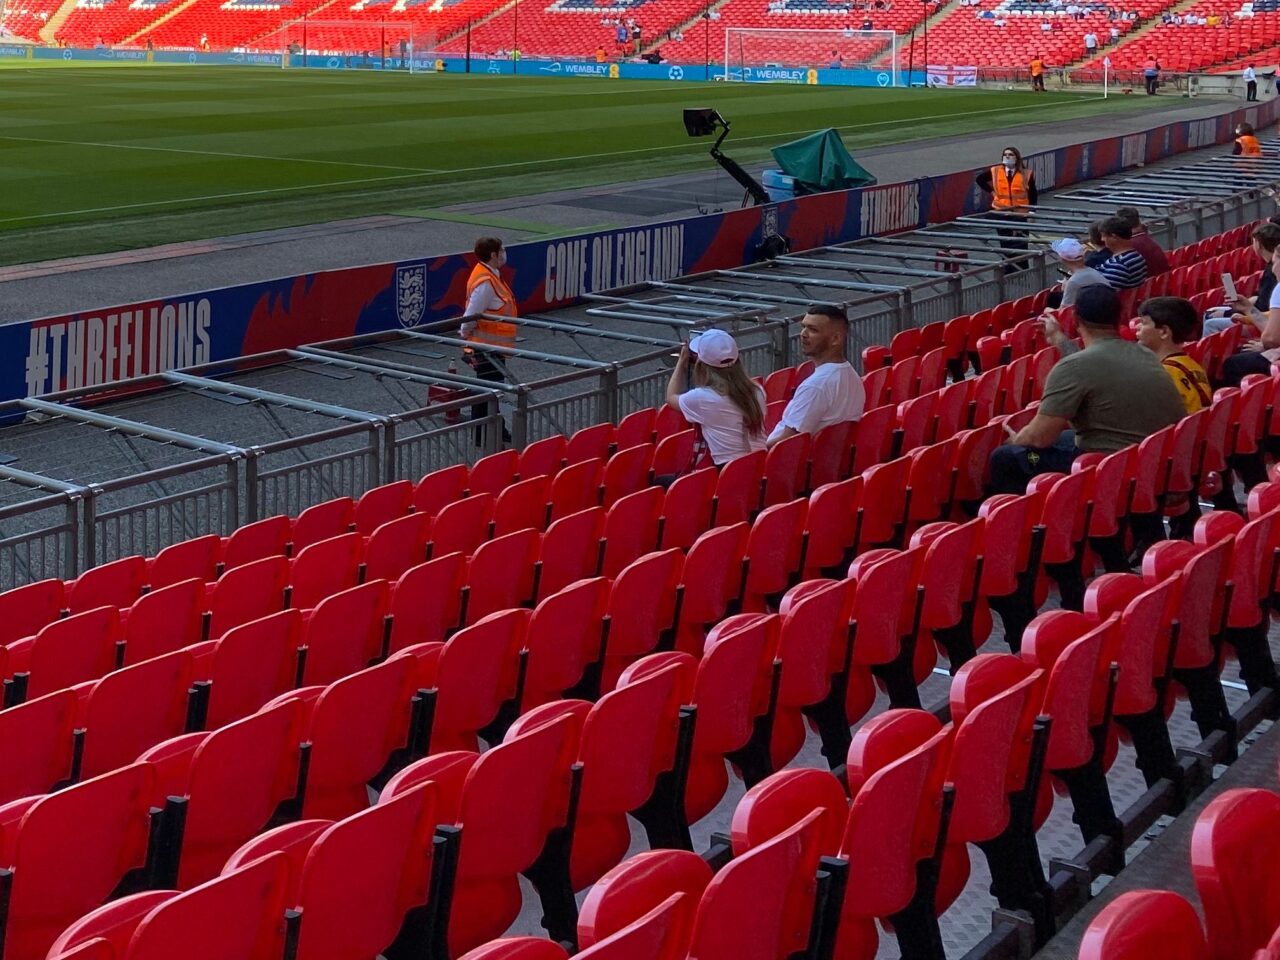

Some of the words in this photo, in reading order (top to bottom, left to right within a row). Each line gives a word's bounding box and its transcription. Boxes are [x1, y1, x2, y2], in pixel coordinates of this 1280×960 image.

[116, 50, 146, 59] WEMBLEY
[247, 55, 280, 64] WEMBLEY
[565, 65, 608, 74] WEMBLEY
[755, 69, 805, 80] WEMBLEY
[860, 183, 919, 236] #THREELIONS
[545, 239, 587, 303] COME
[592, 235, 612, 291] ON
[616, 224, 684, 288] ENGLAND!
[25, 298, 211, 401] #THREELIONS
